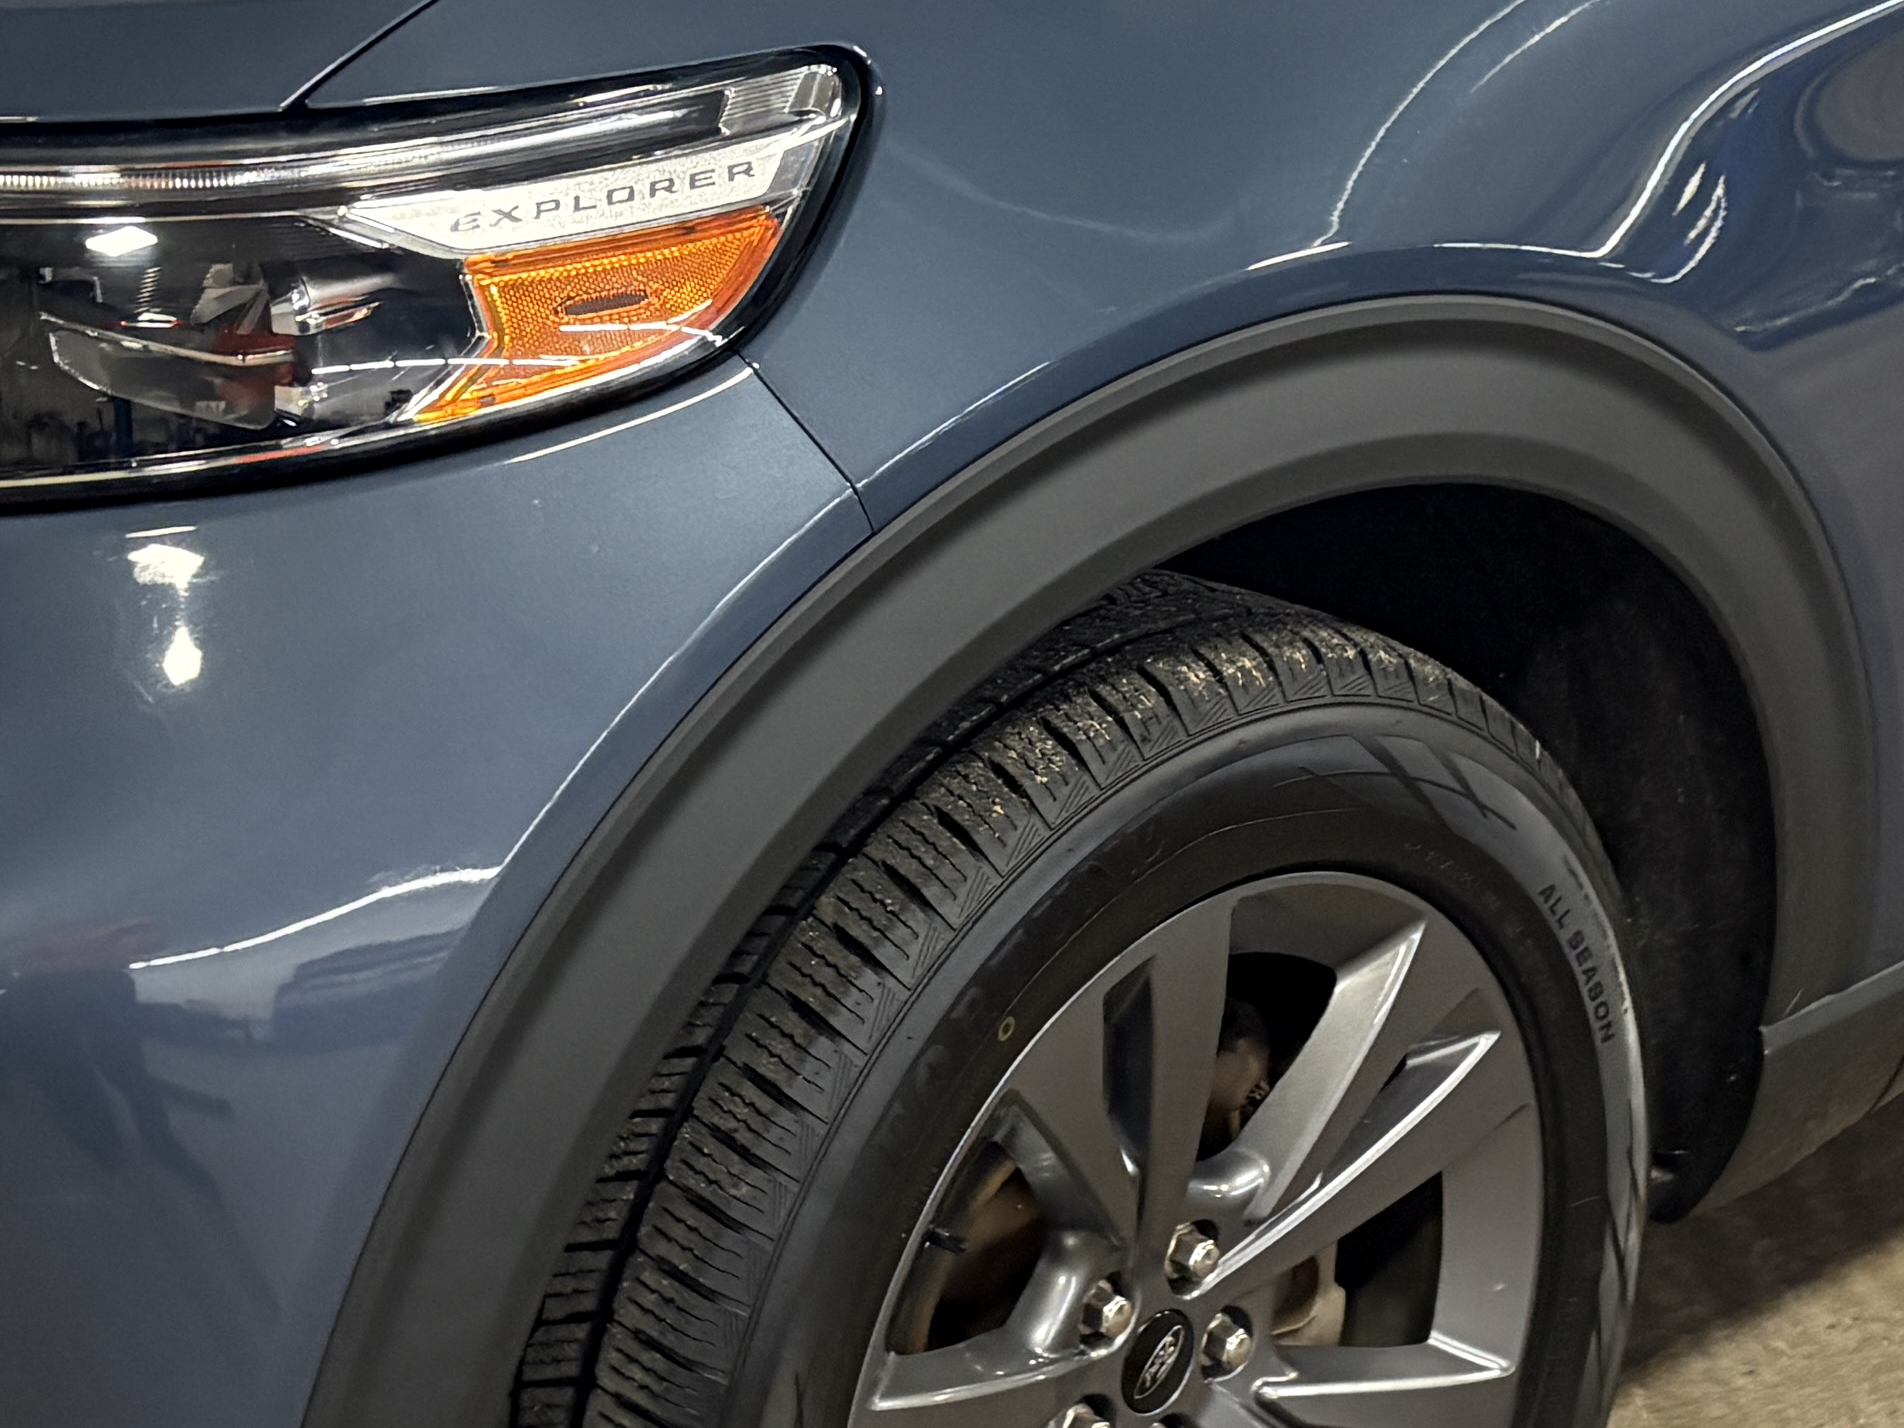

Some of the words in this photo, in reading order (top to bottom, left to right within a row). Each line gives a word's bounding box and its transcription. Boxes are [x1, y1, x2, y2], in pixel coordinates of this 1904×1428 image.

[449, 160, 756, 234] EXPLORER
[1538, 883, 1571, 931] ALL
[1567, 929, 1615, 1044] SEASON
